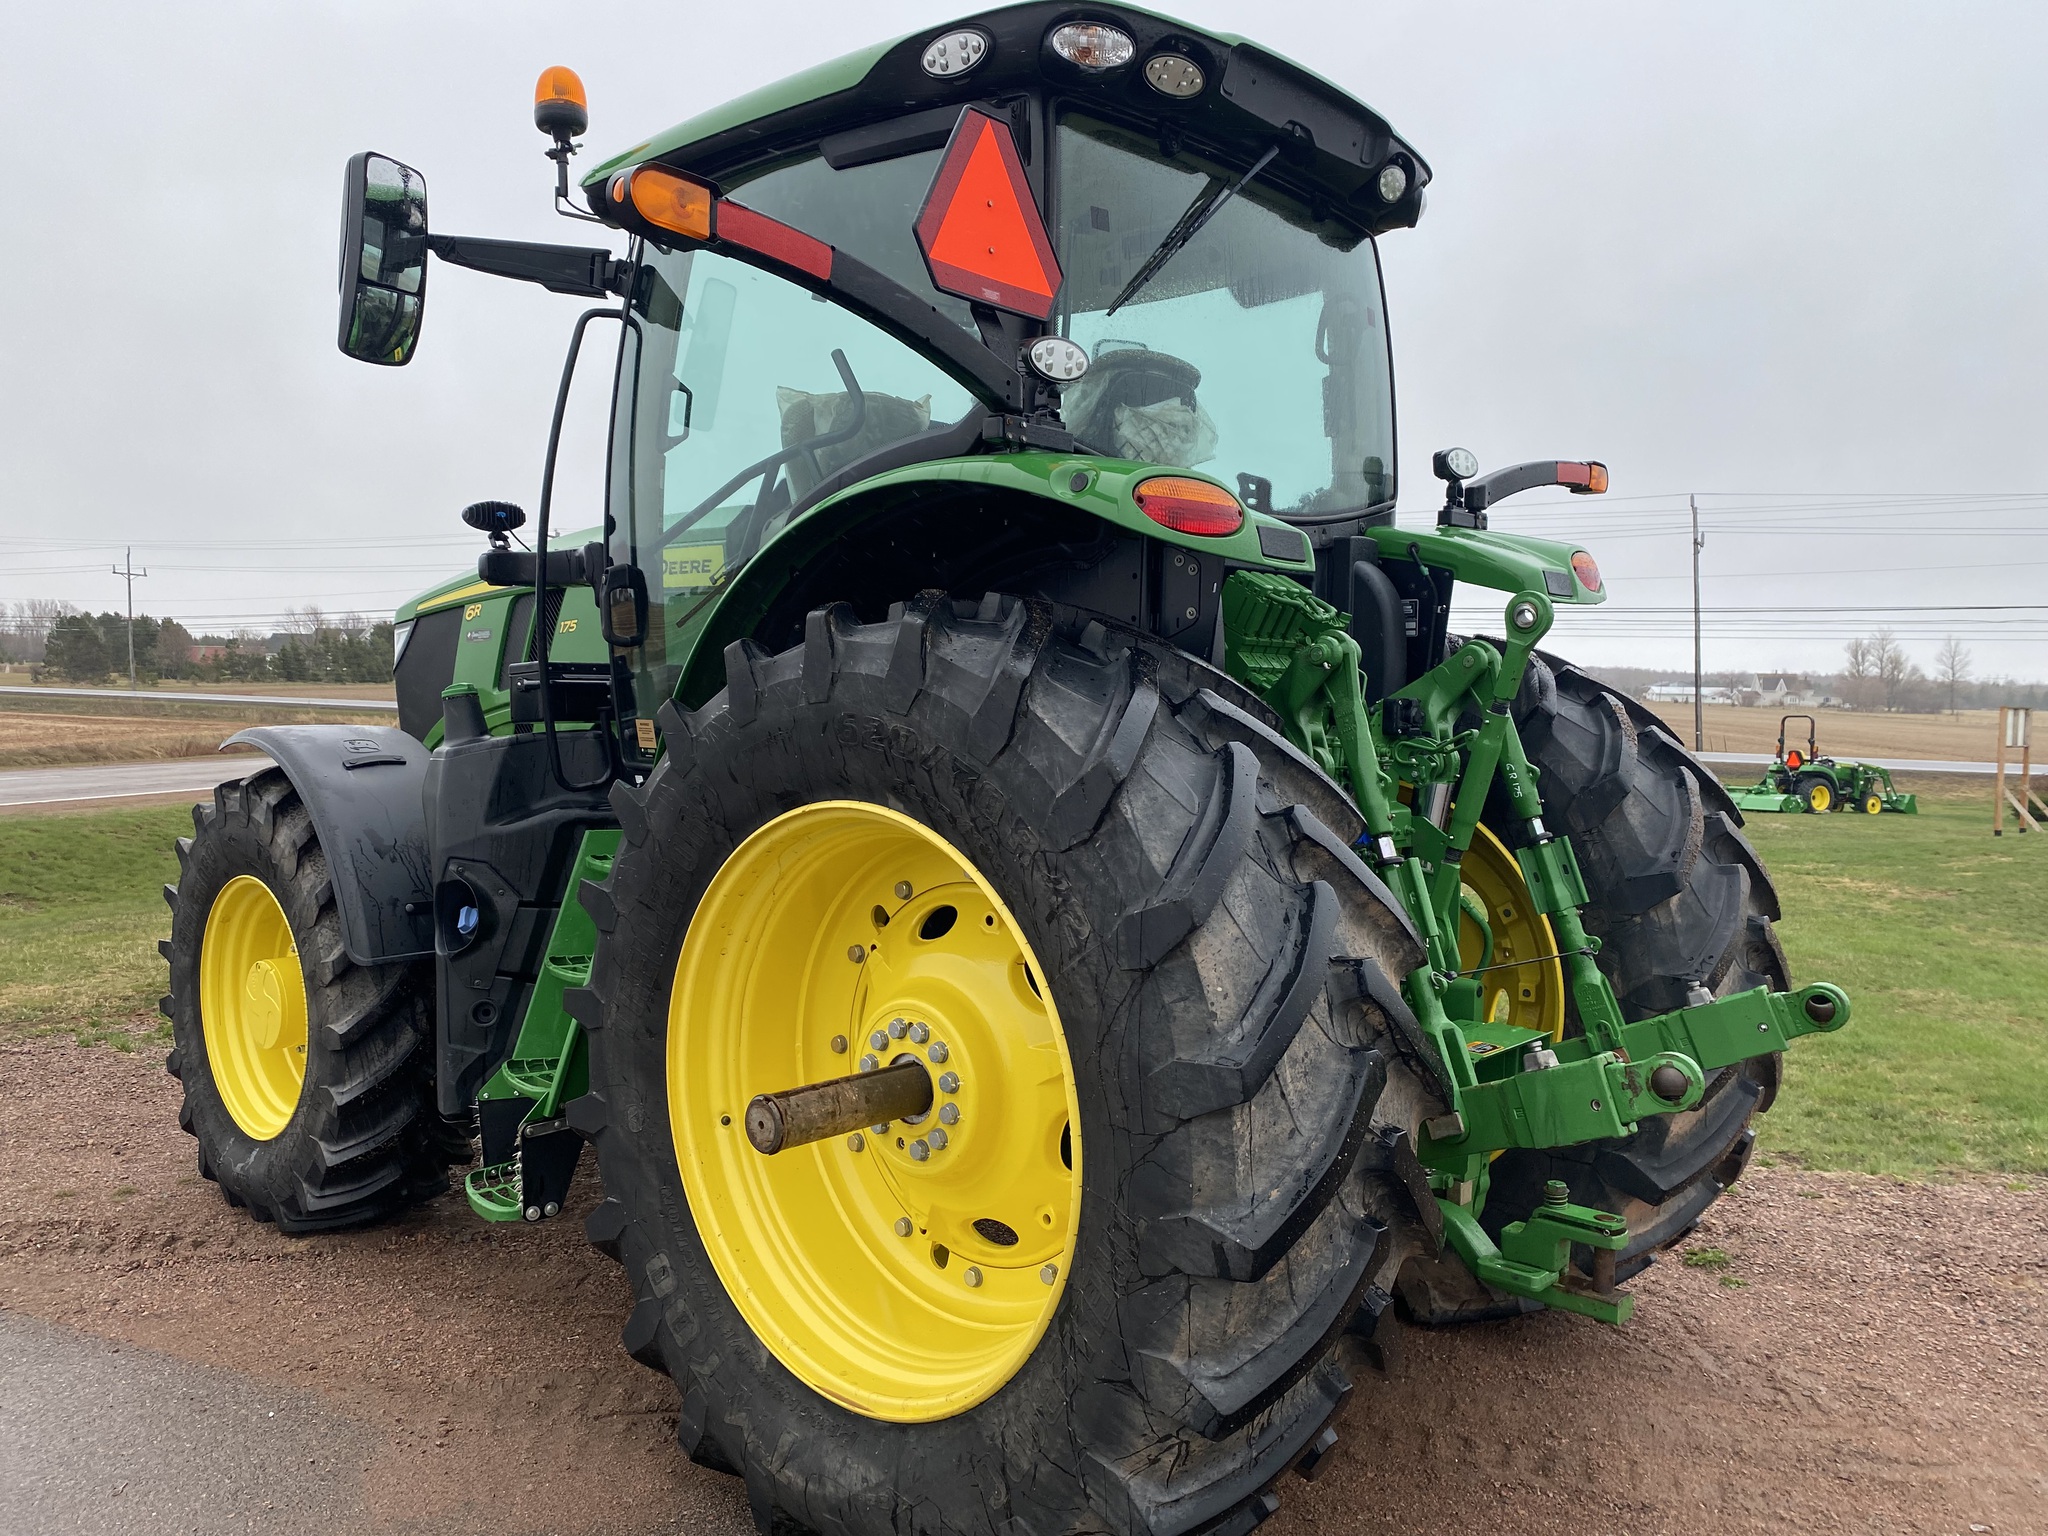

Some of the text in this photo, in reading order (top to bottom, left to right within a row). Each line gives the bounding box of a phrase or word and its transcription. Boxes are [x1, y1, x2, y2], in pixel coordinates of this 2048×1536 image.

[465, 602, 483, 621] 6R
[559, 619, 578, 634] 175
[1512, 782, 1523, 798] 175
